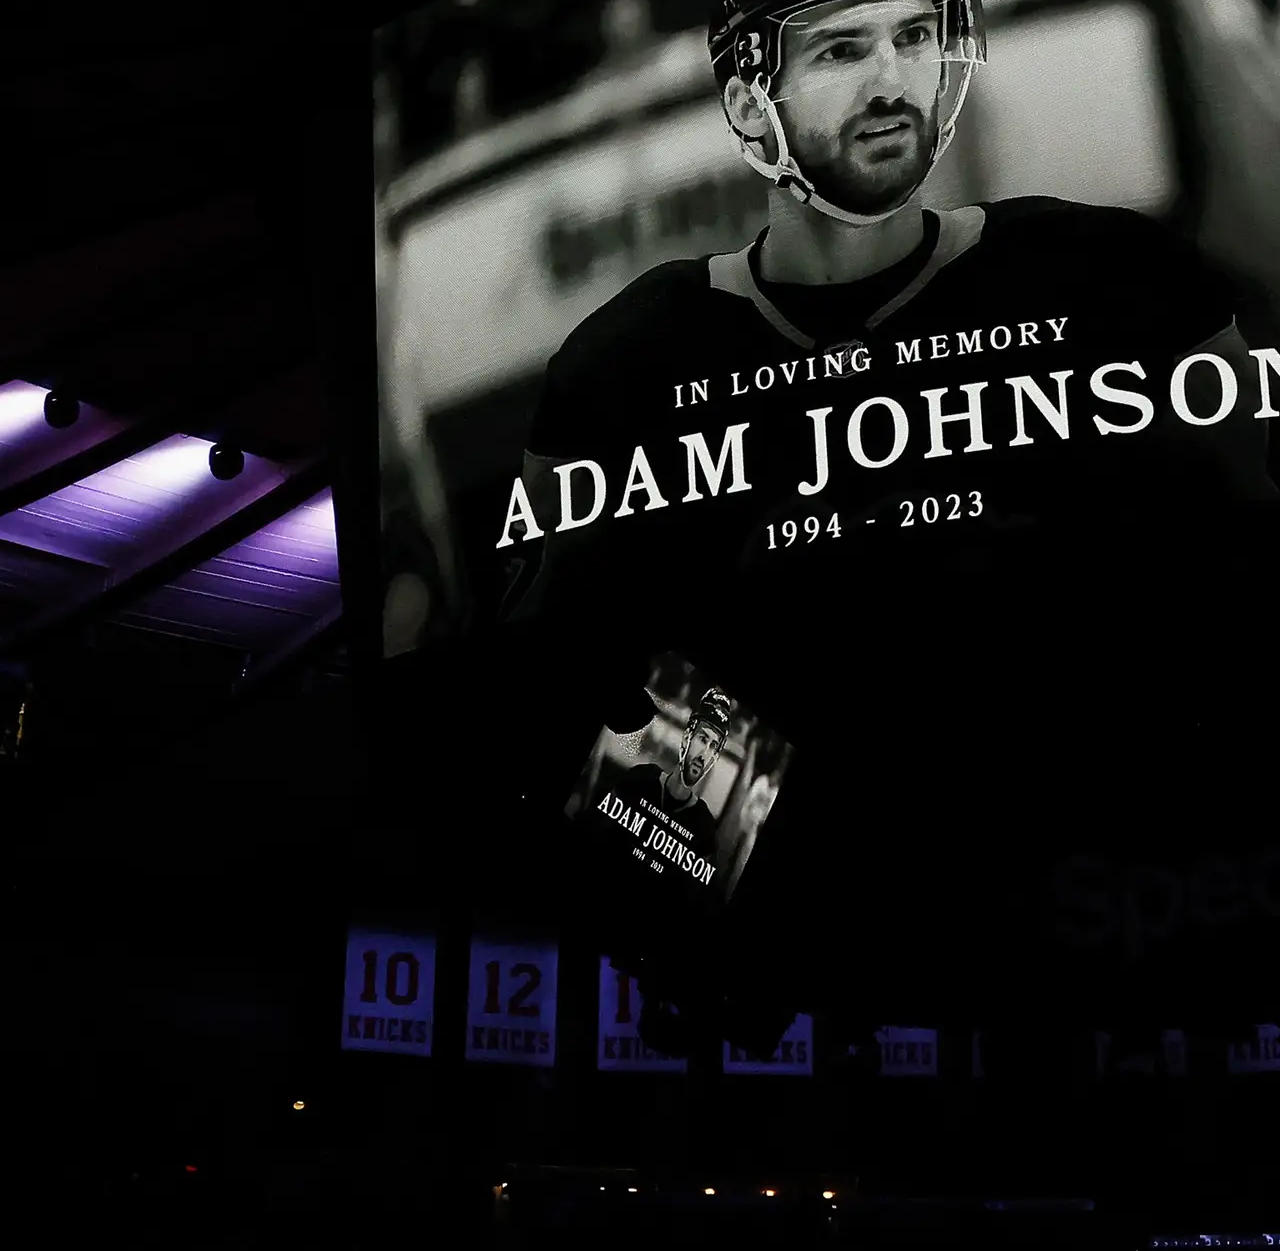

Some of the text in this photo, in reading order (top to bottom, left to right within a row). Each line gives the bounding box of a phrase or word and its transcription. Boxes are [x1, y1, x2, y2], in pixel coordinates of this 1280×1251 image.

[673, 378, 709, 409] IN
[730, 347, 872, 396] LOVING
[894, 316, 1069, 365] MEMORY
[495, 422, 753, 549] ADAM
[766, 512, 842, 550] 1994
[899, 490, 983, 528] 2023
[597, 792, 717, 886] ADAM JOHNSON
[639, 797, 694, 841] IN LOVING MEMORY
[632, 847, 646, 861] 1994
[359, 950, 420, 1005] 10
[483, 961, 542, 1016] 12
[346, 1014, 427, 1044] KNICKS
[472, 1026, 550, 1055] KNICKS
[884, 1041, 933, 1066] ICKS
